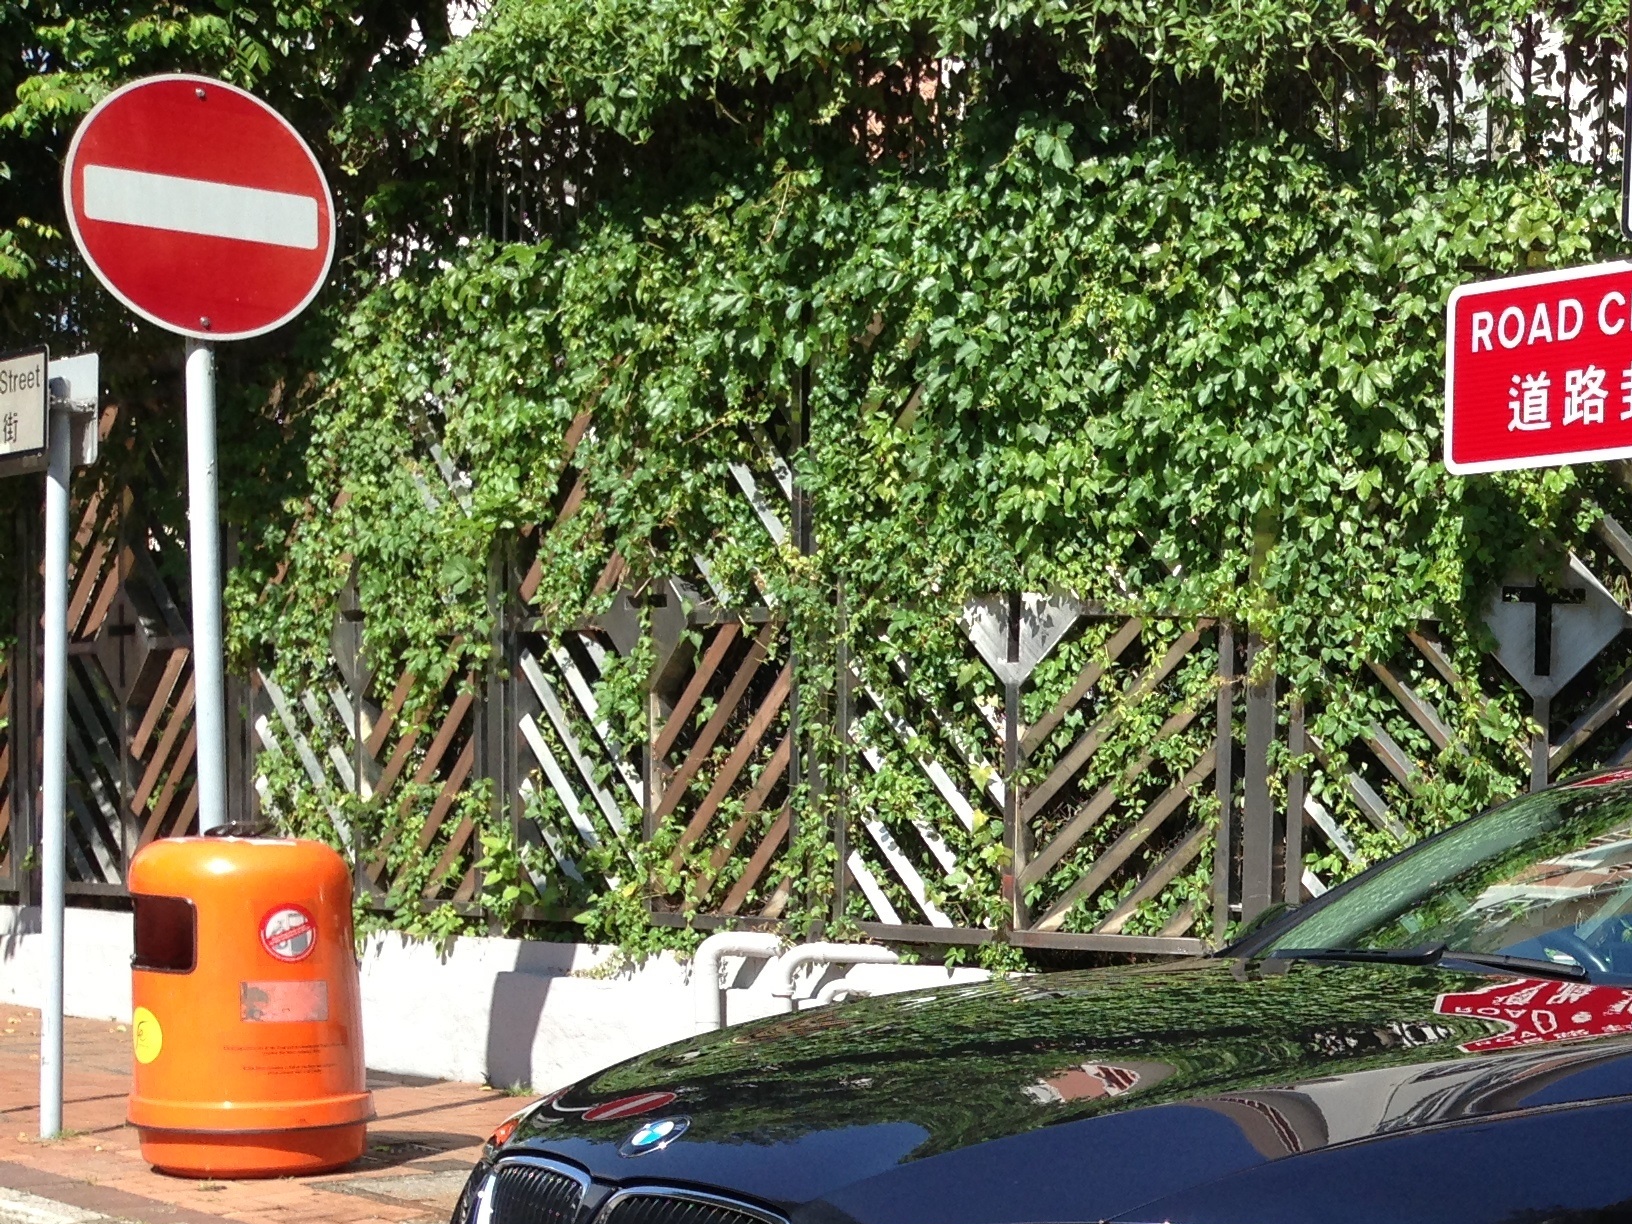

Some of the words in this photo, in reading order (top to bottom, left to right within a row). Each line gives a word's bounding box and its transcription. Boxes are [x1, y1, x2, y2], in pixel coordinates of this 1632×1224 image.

[1471, 299, 1584, 353] ROAD
[0, 364, 40, 394] Street
[3, 412, 18, 443] 街
